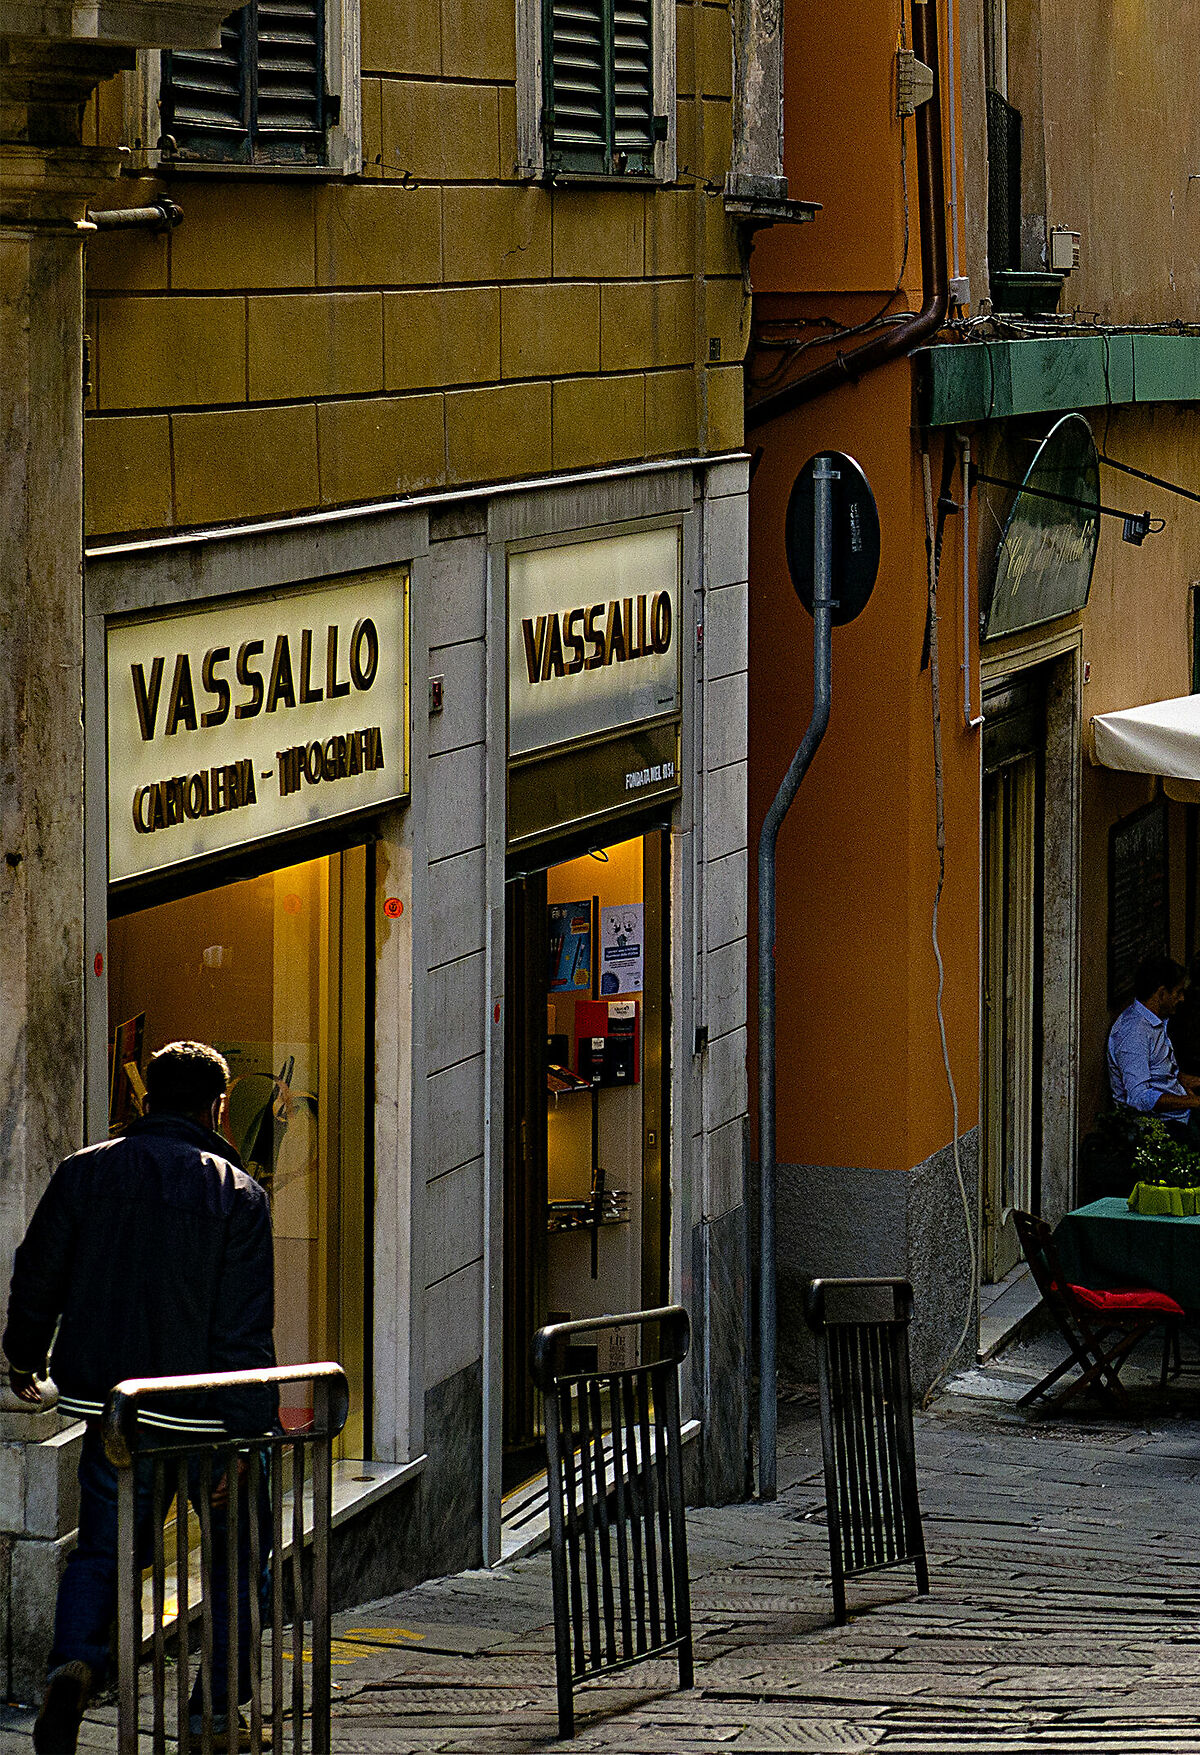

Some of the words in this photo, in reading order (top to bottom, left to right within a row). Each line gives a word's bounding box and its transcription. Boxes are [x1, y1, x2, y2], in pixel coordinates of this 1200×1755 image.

[131, 617, 379, 741] VASSALLO
[522, 591, 672, 683] VASSALLO
[133, 759, 257, 834] CARTOLERIA
[276, 727, 385, 796] TIPOGRAFIA
